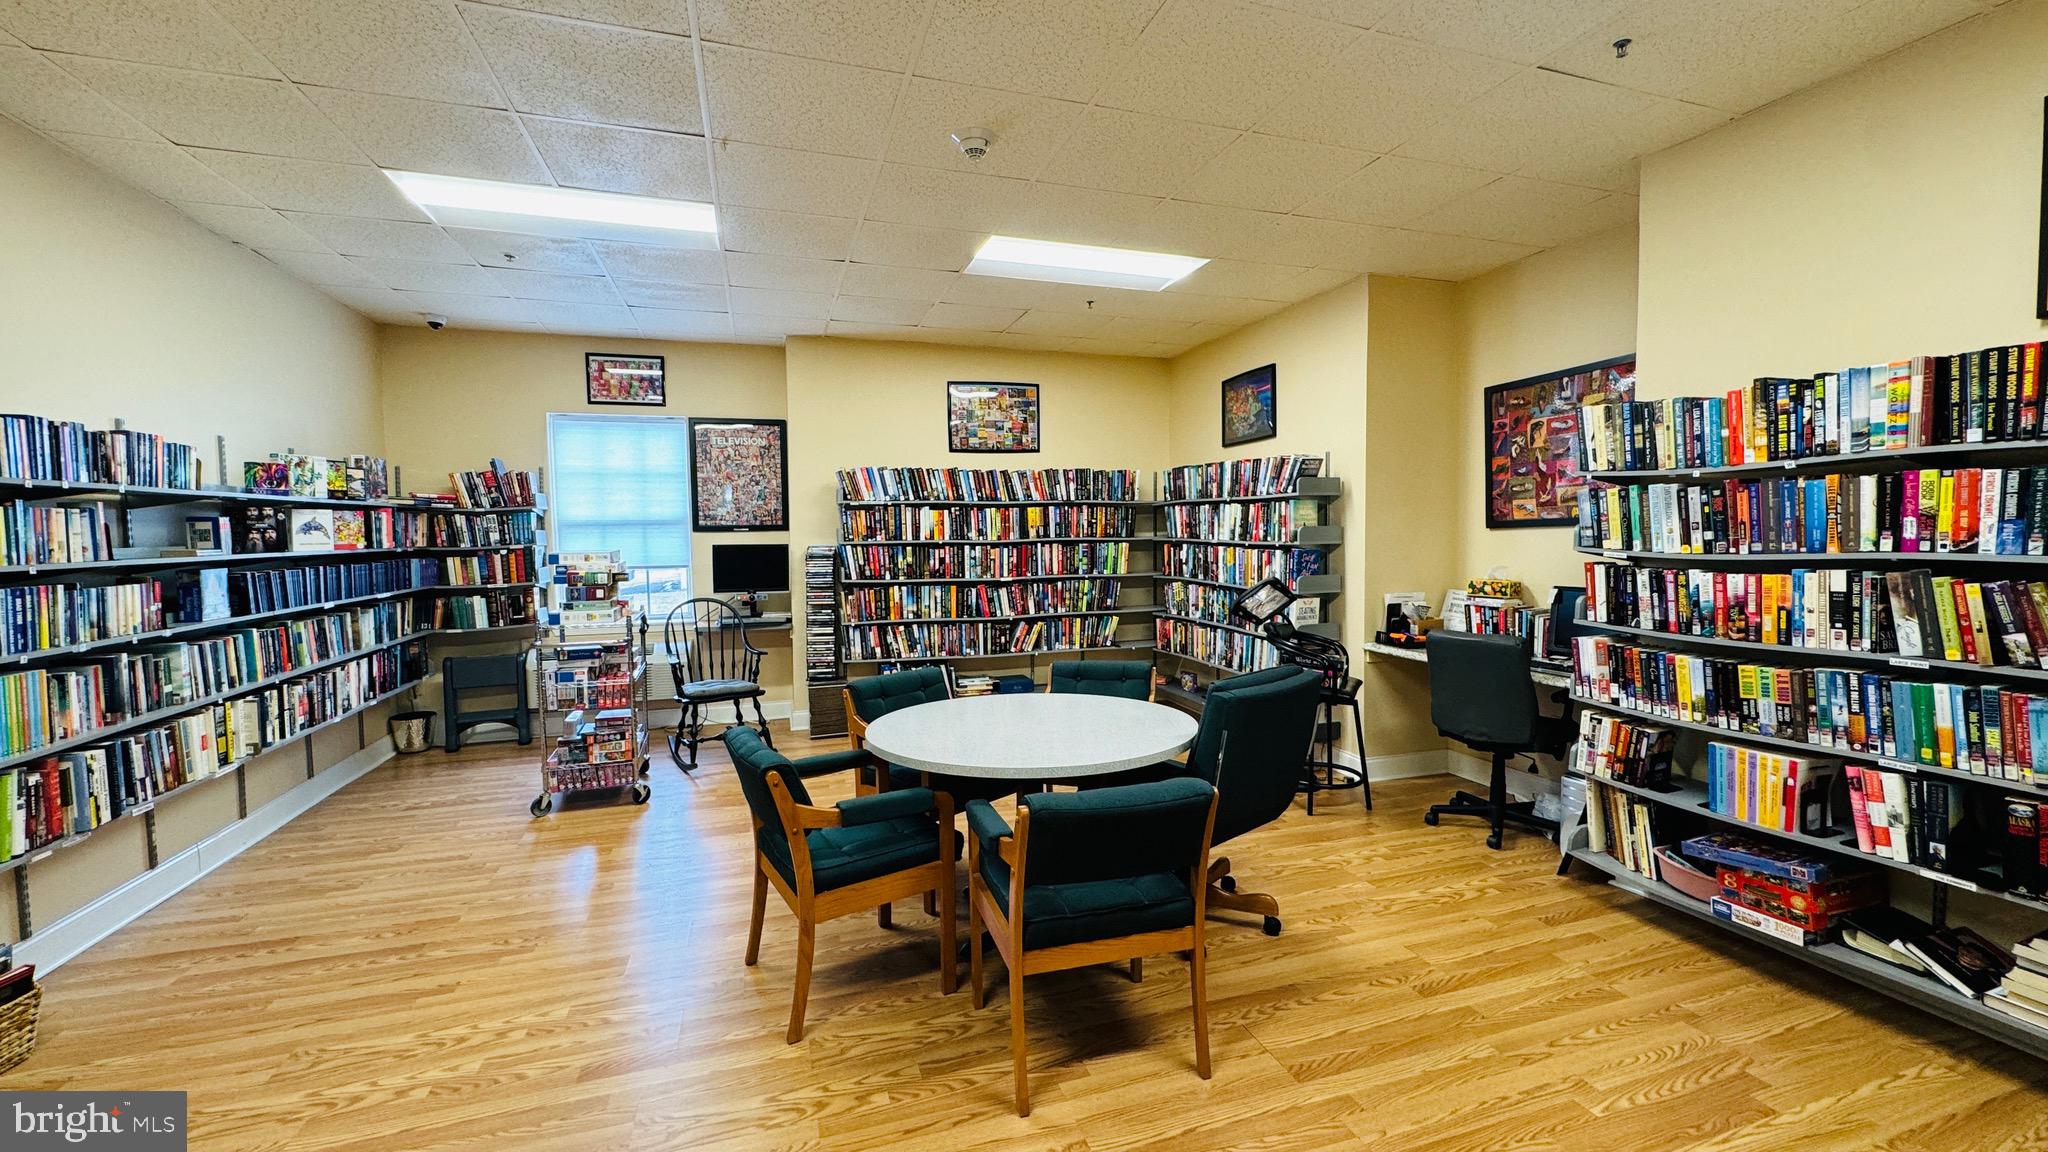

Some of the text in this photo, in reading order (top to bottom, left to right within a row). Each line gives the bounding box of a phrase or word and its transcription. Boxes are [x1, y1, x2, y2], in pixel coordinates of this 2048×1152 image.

[1951, 357, 1960, 379] STUART
[1970, 353, 1980, 378] STUART
[1988, 351, 1998, 374] STUART
[2008, 348, 2018, 372] STUART
[2023, 348, 2035, 396] STUART WOODS
[1768, 386, 1776, 400] KATE
[1951, 380, 1960, 403] WOODS
[1971, 378, 1980, 400] WOODS
[1988, 375, 1998, 399] WOODS
[2006, 374, 2016, 400] WOODS
[711, 436, 767, 447] TELEVISION
[1778, 414, 1788, 452] NIGHT MOVES
[1920, 480, 1928, 500] COOK
[1984, 472, 1996, 520] PATRICIA CORNWELL
[2003, 470, 2020, 540] PATRICIA CORNWELL dust
[1828, 521, 1836, 545] PERSONAL
[1852, 582, 1860, 594] LORA
[1852, 594, 1861, 608] LEIGH
[1992, 592, 2011, 624] CARLA NEGGERS
[1742, 681, 1754, 696] ROBB
[1760, 682, 1770, 698] ROBB
[1778, 686, 1790, 702] ROBB
[1850, 674, 1860, 712] JAMES ROLLINS
[1984, 696, 1998, 728] SANDFORD
[1968, 710, 1980, 742] John Sandford
[2008, 816, 2035, 828] ALASKA
[1724, 873, 1738, 888] 8
